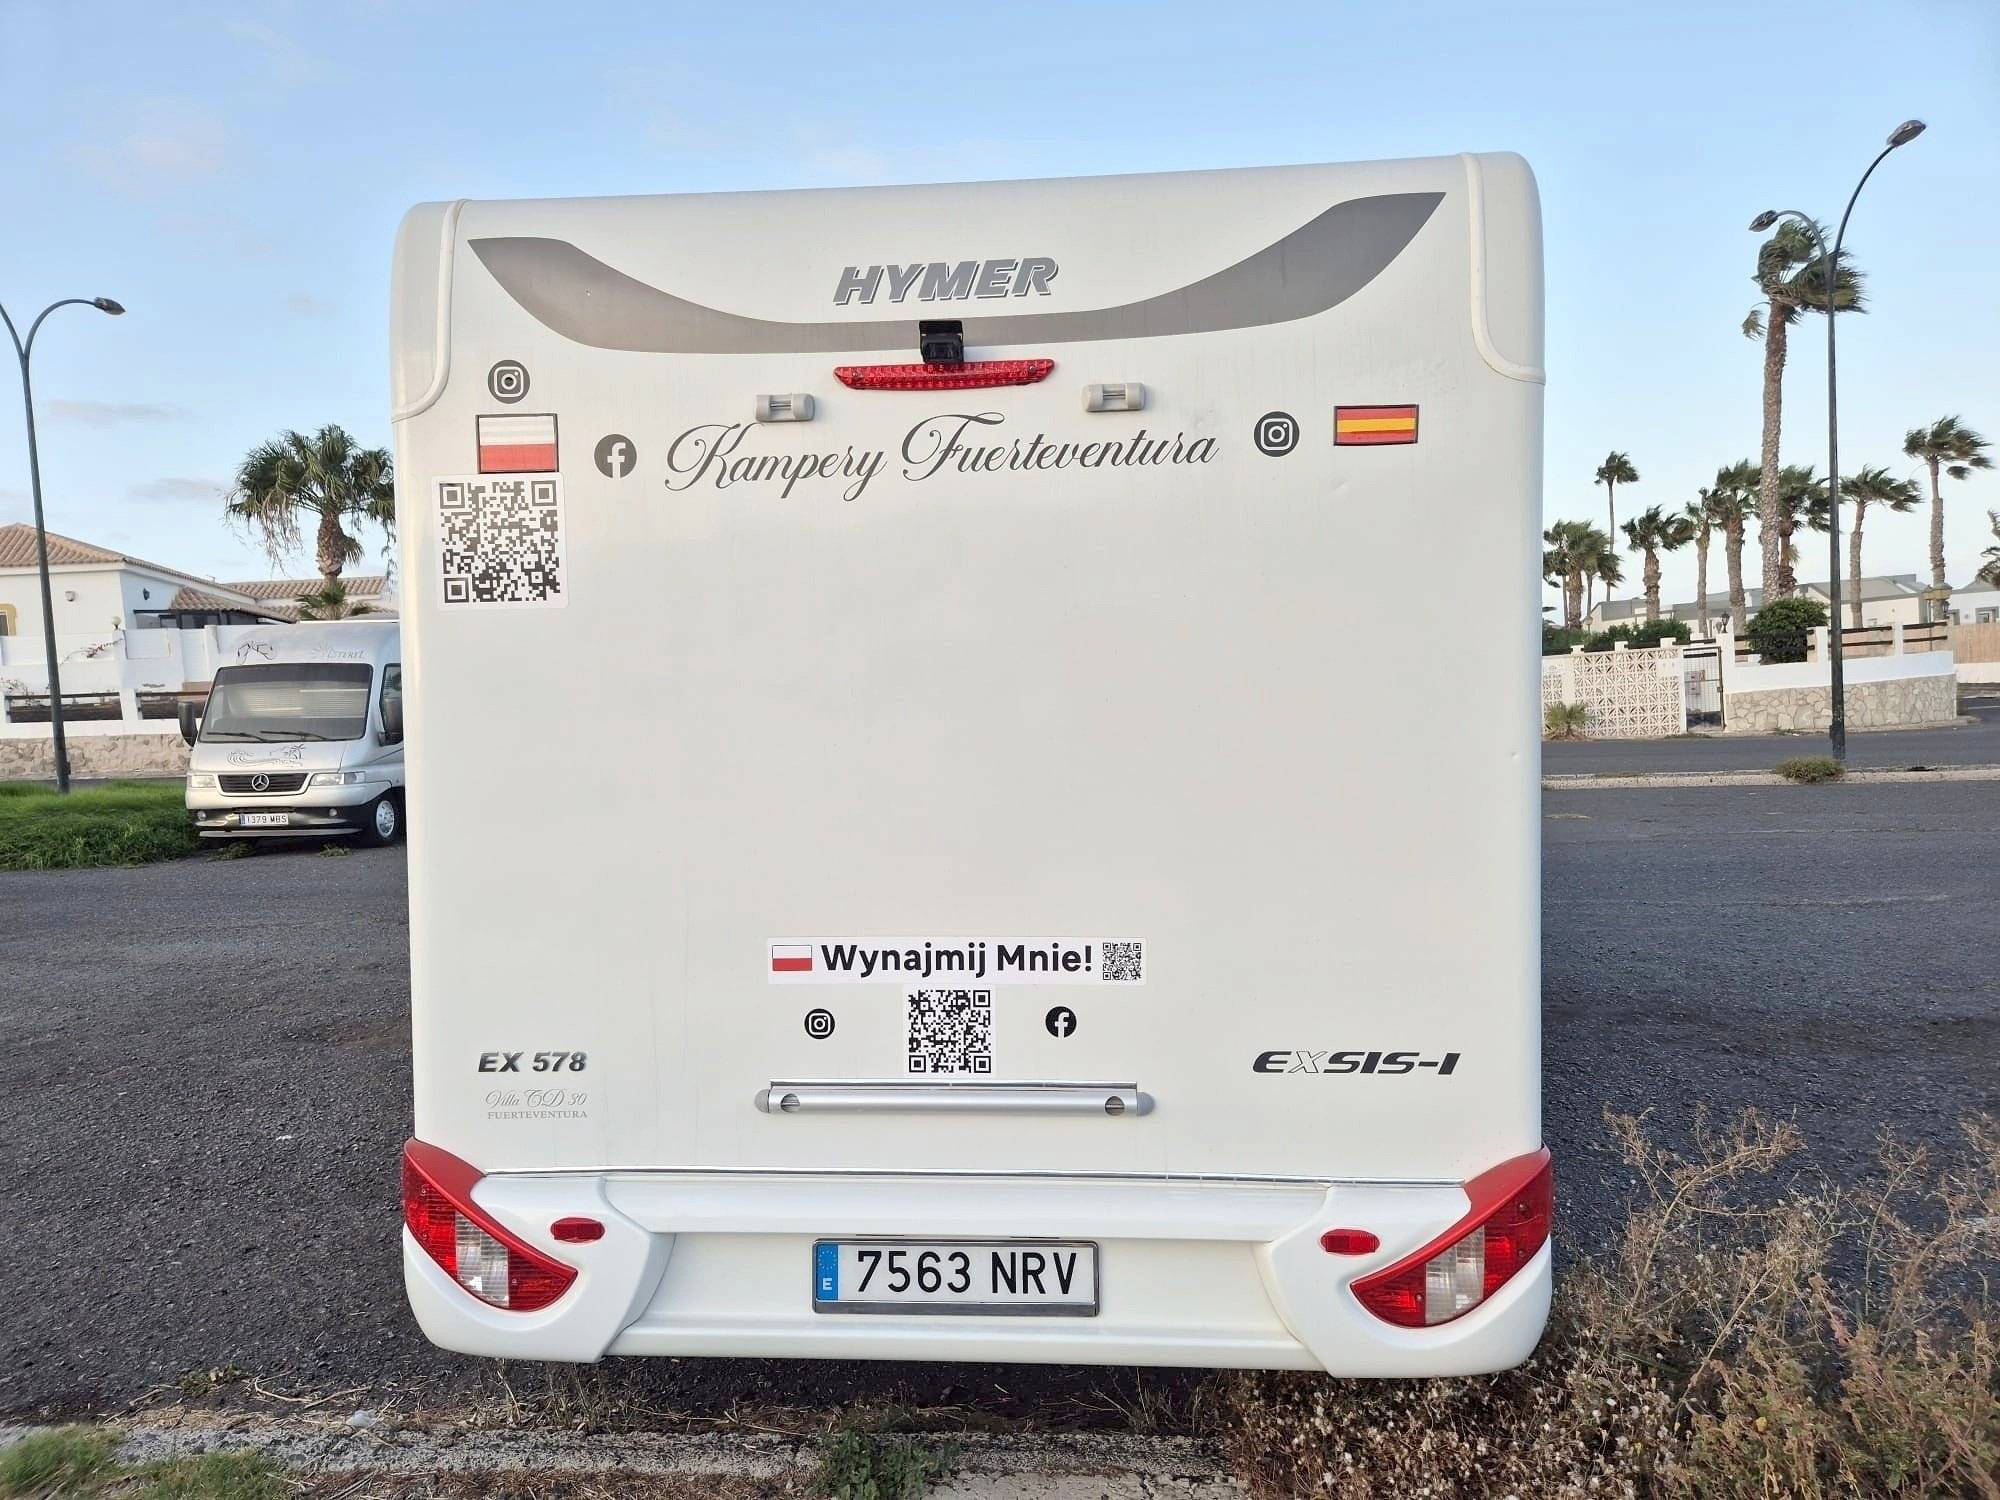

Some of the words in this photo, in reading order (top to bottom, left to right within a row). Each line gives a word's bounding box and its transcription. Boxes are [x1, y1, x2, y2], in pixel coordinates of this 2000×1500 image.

[833, 257, 1059, 305] HYMER
[664, 422, 887, 502] Kampery
[901, 411, 1221, 482] Fuerteventura
[821, 942, 987, 978] Wynajmij
[998, 943, 1093, 972] Mnie!
[478, 1052, 524, 1073] EX
[532, 1051, 587, 1072] 578
[1252, 1050, 1461, 1075] EXSIS-I
[485, 1089, 520, 1108] Villa
[487, 1110, 588, 1120] FUERTEVENTURA
[822, 1277, 832, 1290] E
[857, 1250, 971, 1293] 7563
[991, 1252, 1077, 1295] NRV
